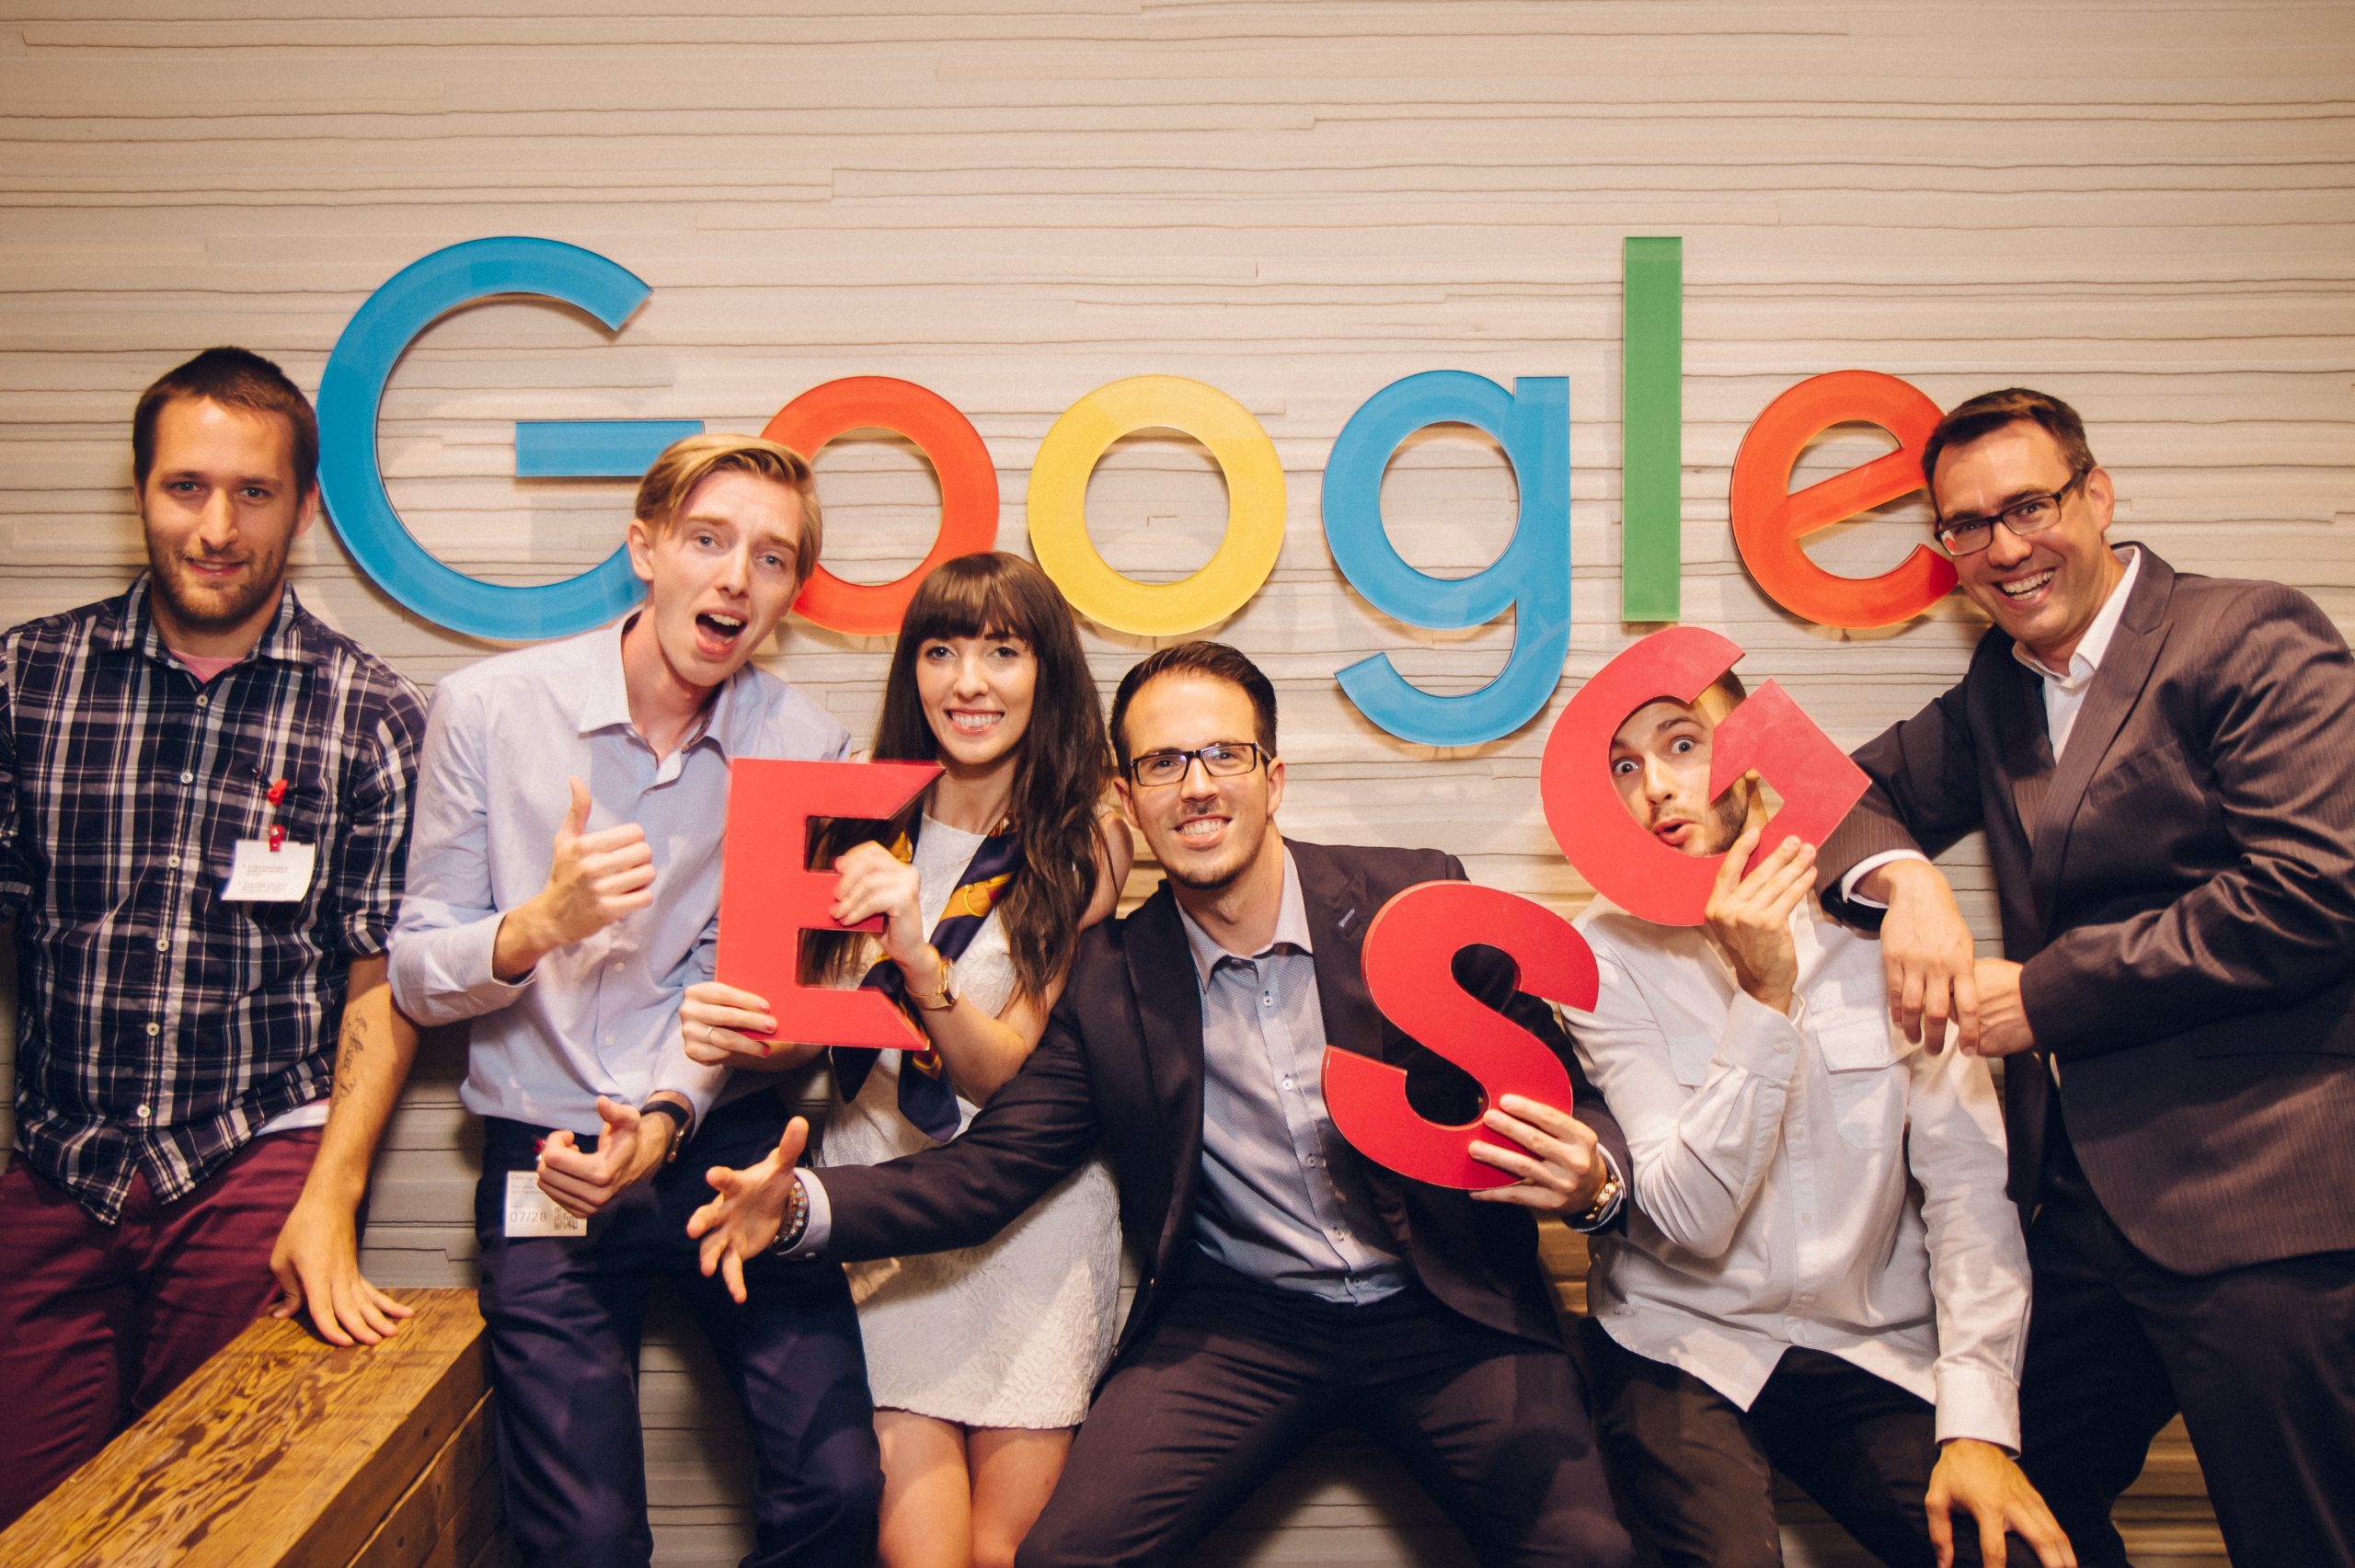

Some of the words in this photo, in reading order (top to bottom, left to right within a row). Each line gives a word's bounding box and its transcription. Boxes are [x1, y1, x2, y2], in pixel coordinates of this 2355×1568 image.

[316, 235, 1959, 747] Google
[715, 759, 943, 1050] E
[1323, 880, 1600, 1190] S
